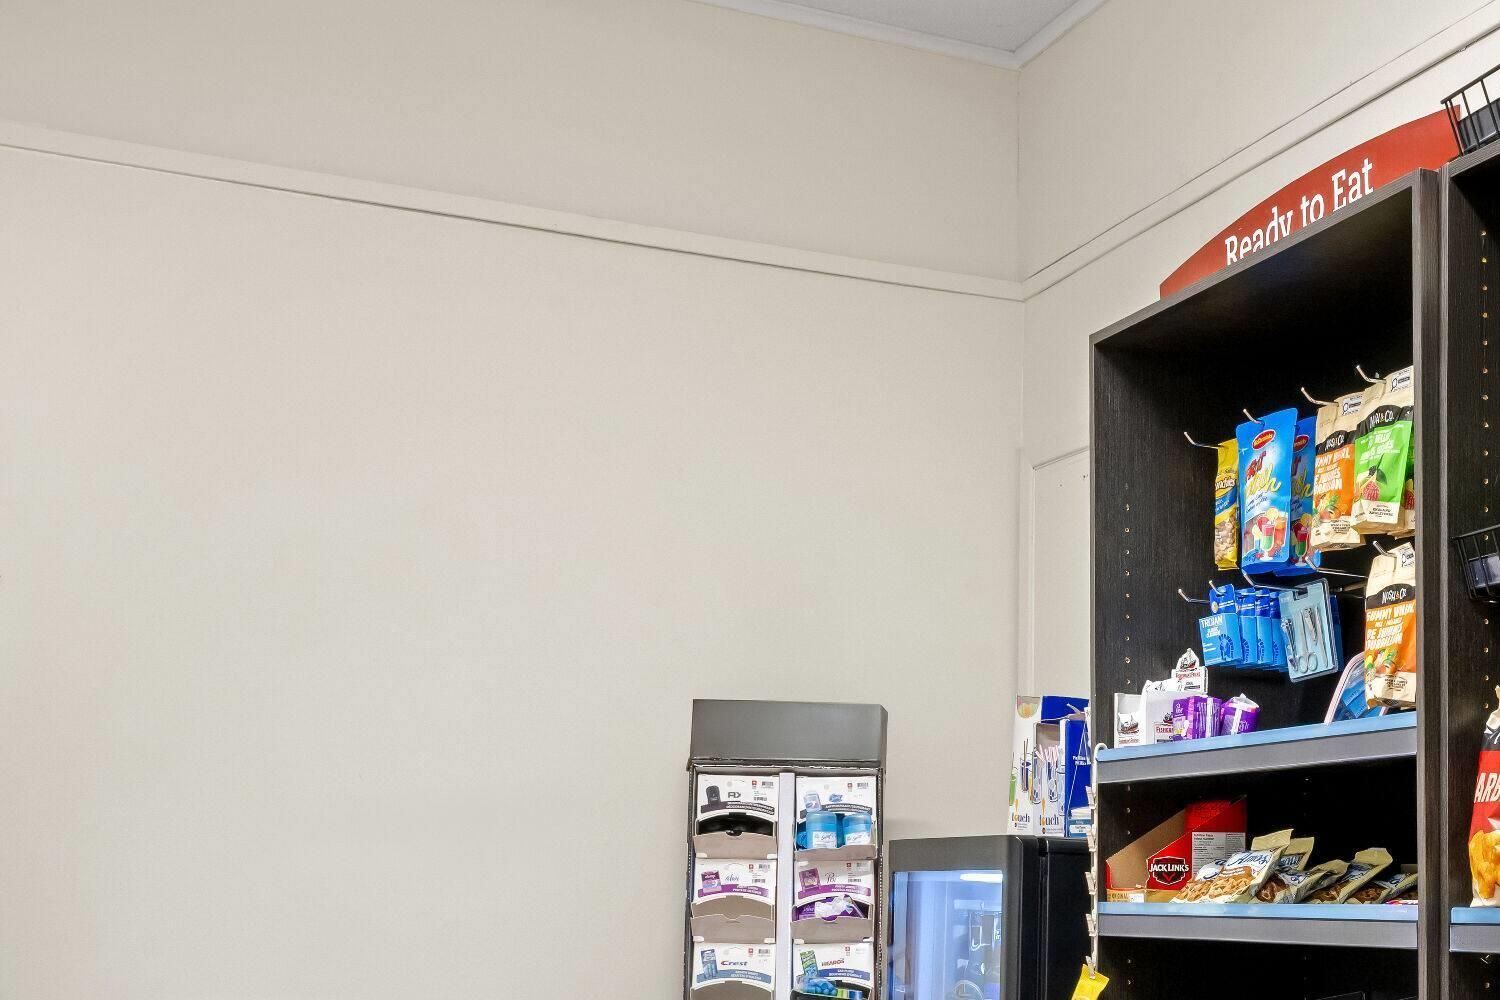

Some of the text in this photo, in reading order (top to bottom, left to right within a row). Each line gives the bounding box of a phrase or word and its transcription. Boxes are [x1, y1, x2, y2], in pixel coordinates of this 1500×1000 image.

[1301, 193, 1325, 227] to
[1331, 158, 1374, 212] Eat
[1149, 863, 1166, 873] JACK
[720, 959, 748, 967] Crest
